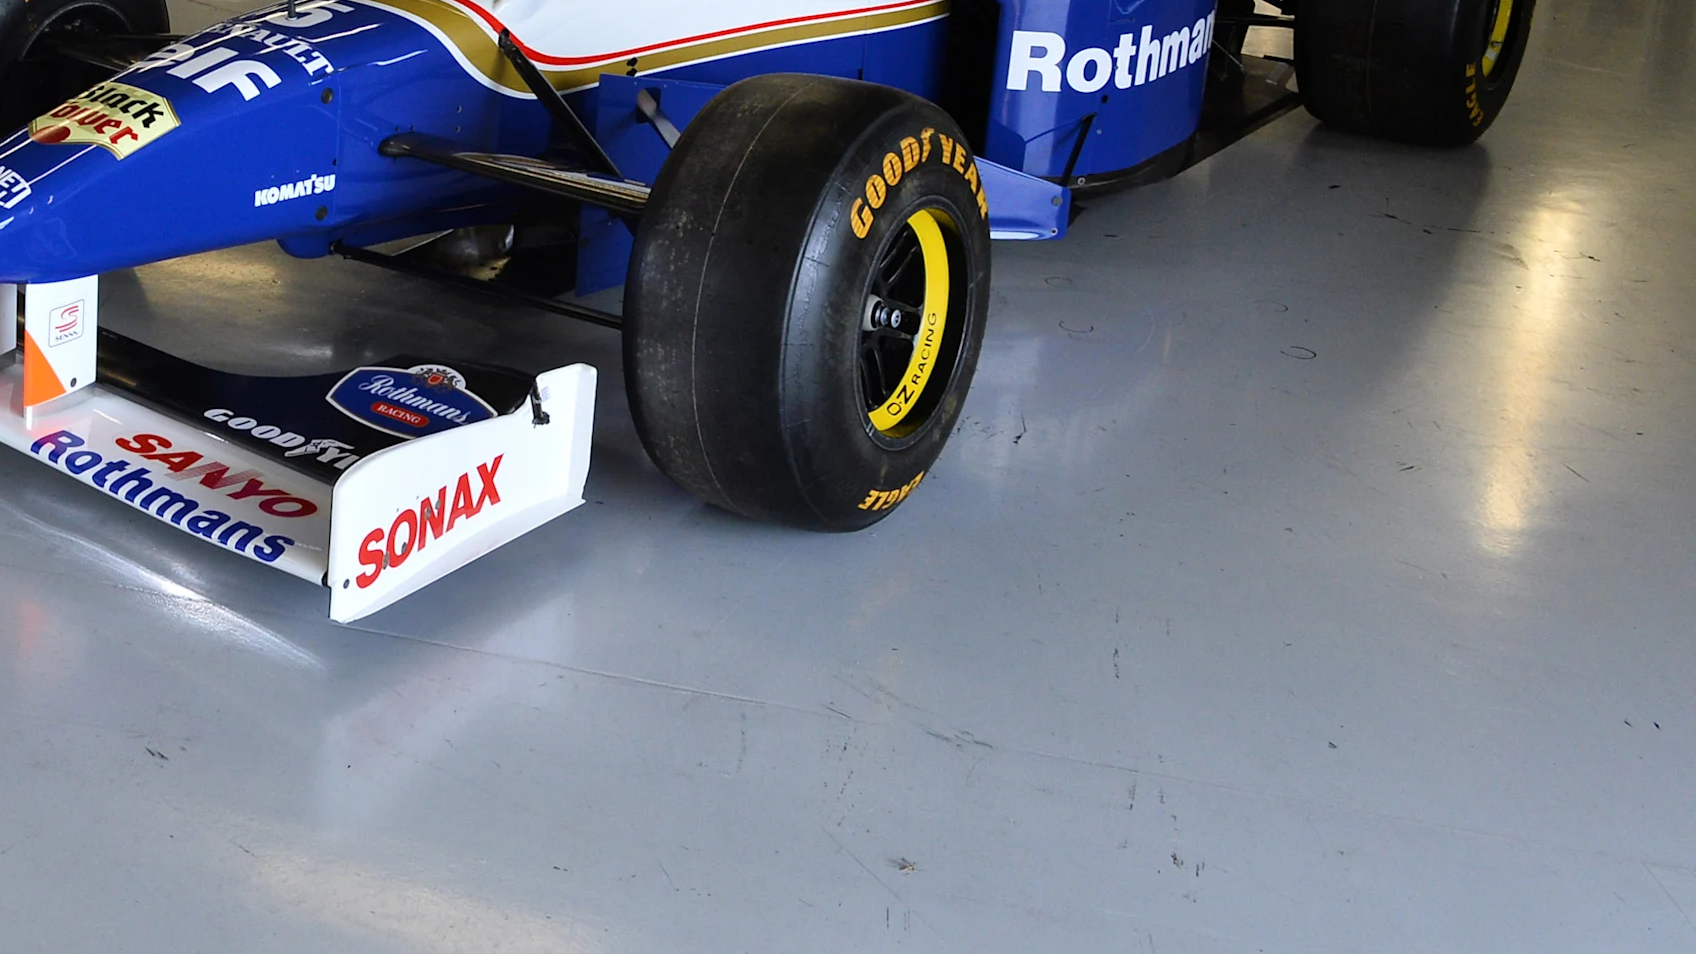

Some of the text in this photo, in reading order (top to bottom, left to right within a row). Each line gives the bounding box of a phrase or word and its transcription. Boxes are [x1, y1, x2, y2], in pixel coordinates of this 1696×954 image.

[136, 43, 282, 102] elf
[1006, 9, 1215, 93] Rothman
[48, 104, 139, 144] ower
[253, 173, 336, 207] KOMATSU
[850, 127, 989, 239] GOODYEAR
[911, 312, 937, 386] RACING
[358, 374, 471, 425] Rothmans
[377, 404, 422, 425] RACING
[204, 407, 361, 471] GOODY
[30, 429, 297, 564] Rothmans
[115, 432, 318, 518] SANYO
[858, 471, 924, 511] EAGLE
[355, 452, 505, 590] SONAX
